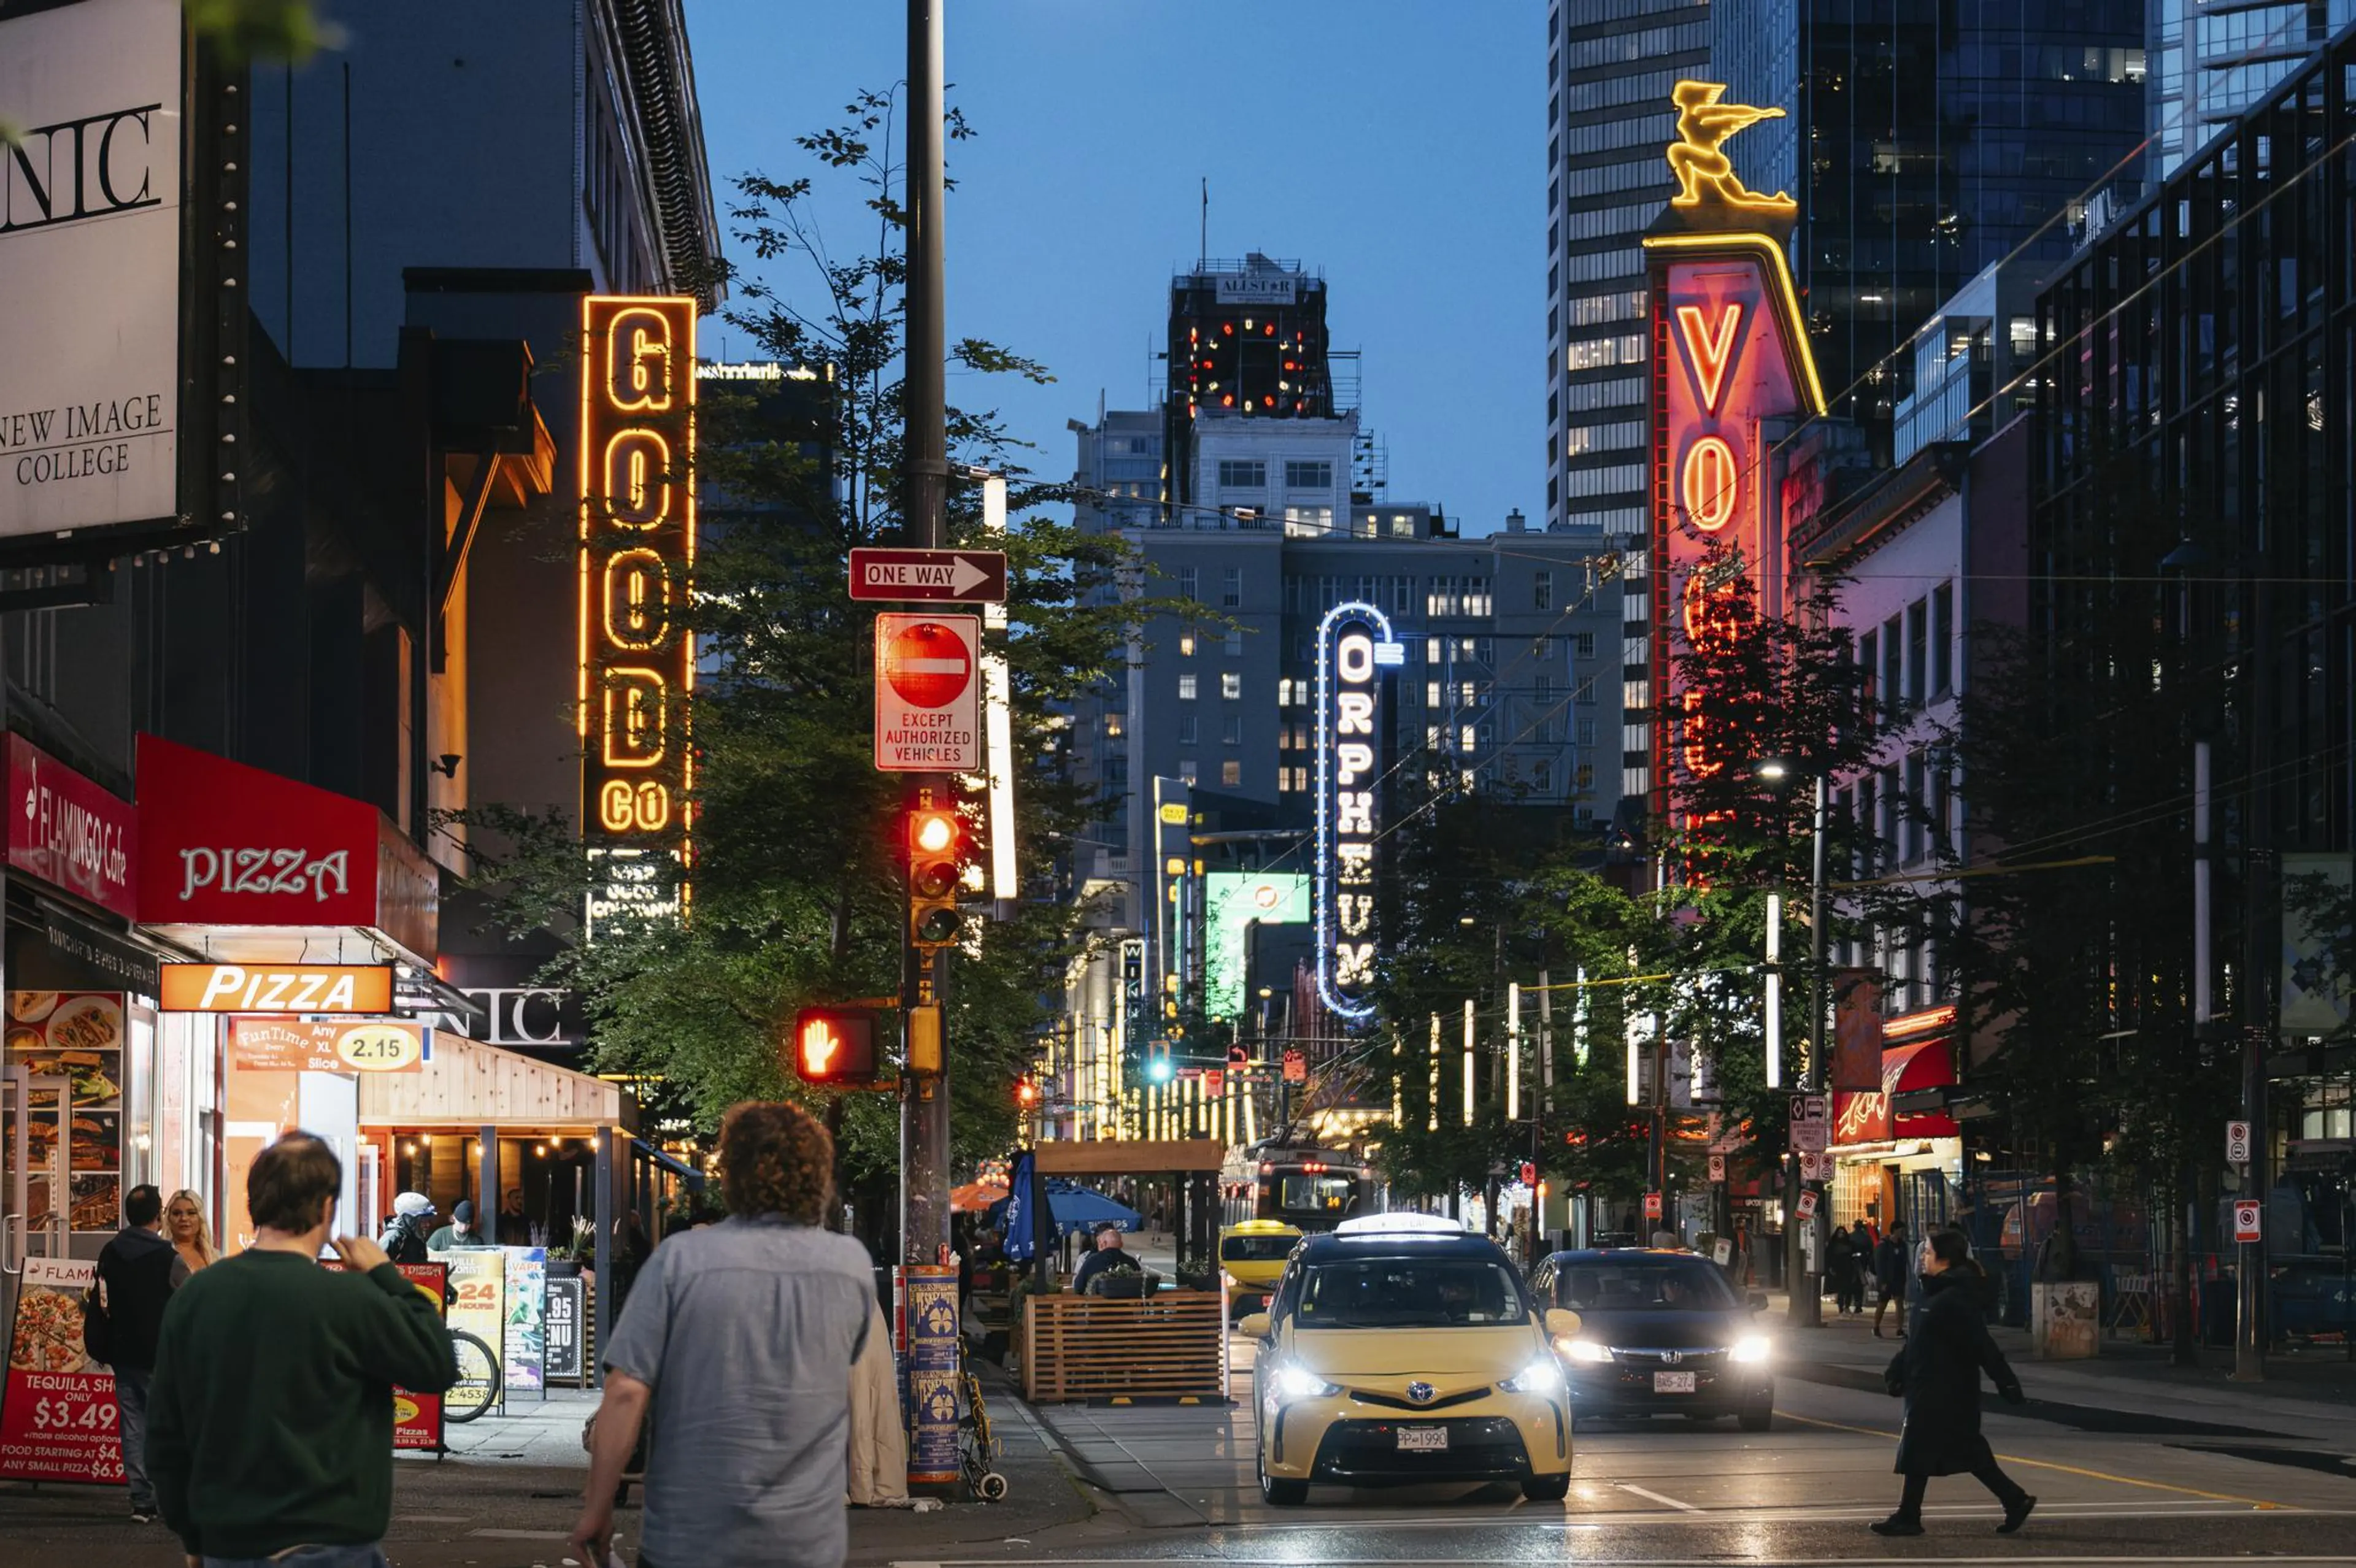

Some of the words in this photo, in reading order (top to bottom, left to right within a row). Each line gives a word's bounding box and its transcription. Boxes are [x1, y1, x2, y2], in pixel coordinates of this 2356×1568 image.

[0, 409, 56, 448] NEW
[65, 394, 162, 439] IMAGE
[17, 444, 129, 485] COLLEGE
[604, 307, 671, 769] GOOD
[868, 566, 907, 583] ONE
[916, 566, 954, 585] WAY
[902, 713, 953, 728] EXCEPT
[885, 730, 971, 745] AUTHORIZED
[895, 747, 961, 762] VEHICLES
[1336, 634, 1375, 986] ORPHEUM
[40, 785, 102, 874] FLAMINGO
[312, 1025, 337, 1038] Any
[316, 1041, 332, 1054] XL
[353, 1039, 401, 1058] 2.15
[308, 1057, 339, 1070] Slice
[459, 1283, 496, 1301] 24
[546, 1297, 571, 1318] .95
[26, 1375, 89, 1391] TEQUILA
[93, 1378, 116, 1393] SH
[65, 1392, 92, 1402] ONLY
[33, 1397, 118, 1430] $3.49
[54, 1432, 88, 1442] alcohol
[90, 1434, 121, 1443] options
[1, 1445, 31, 1455] FOOD
[34, 1447, 83, 1458] STARTING
[83, 1449, 97, 1459] AT
[3, 1460, 26, 1470] ANY
[27, 1461, 60, 1472] SMALL
[62, 1463, 90, 1473] PIZZA
